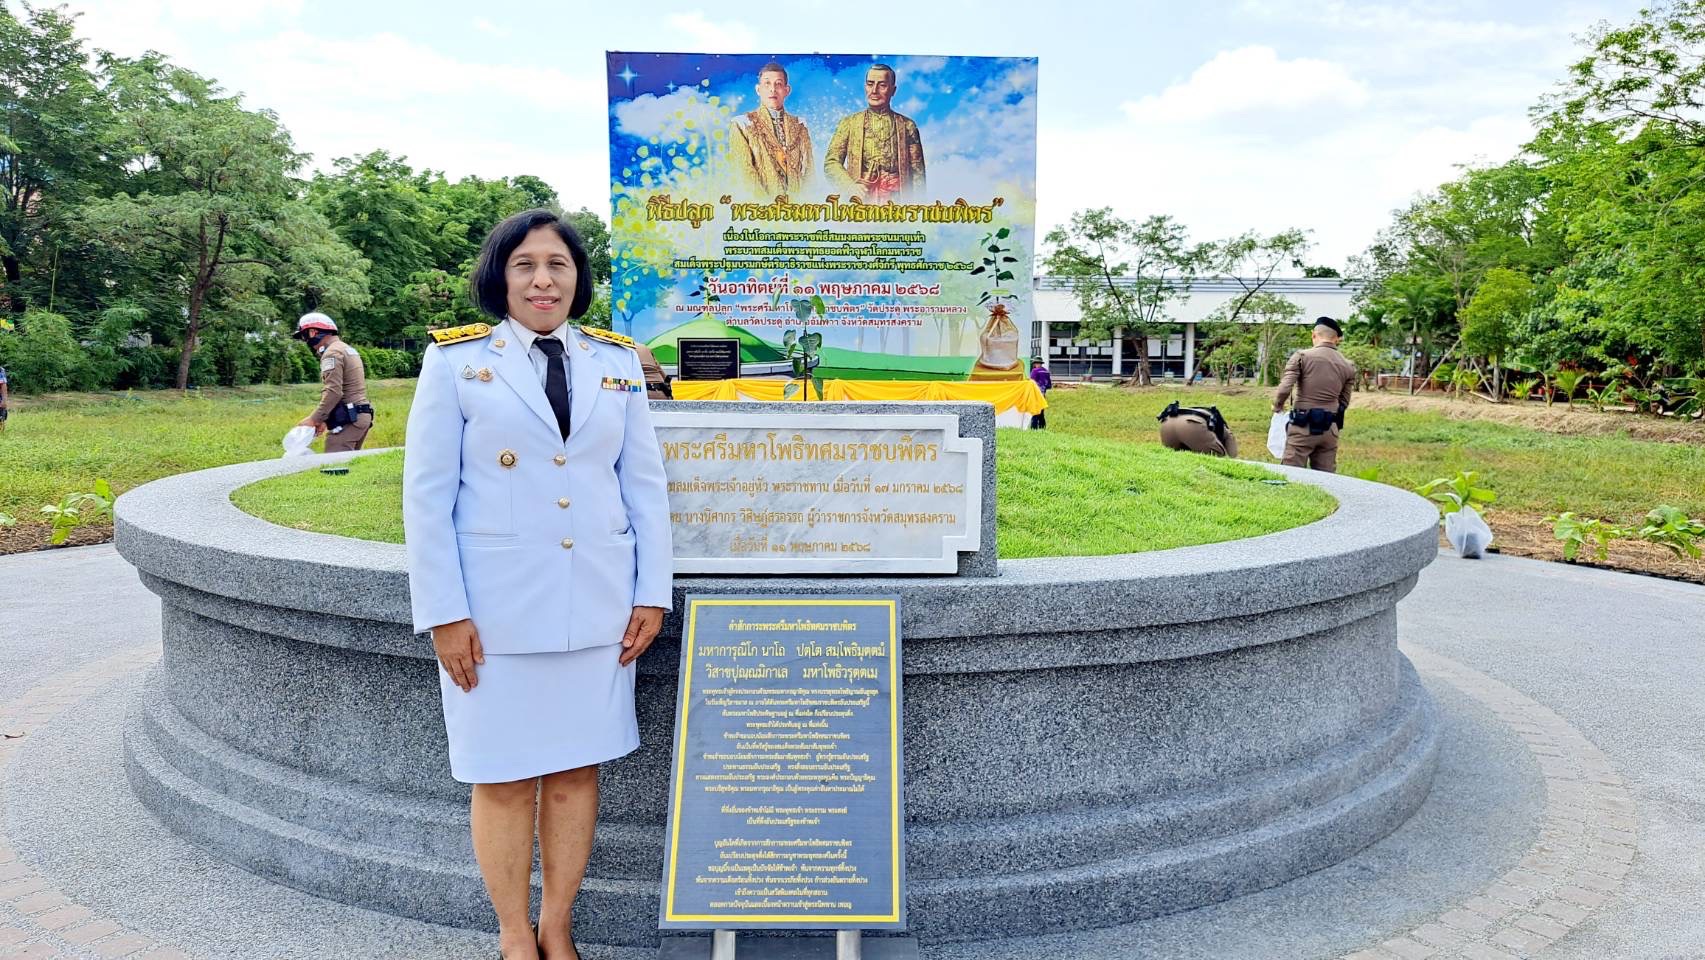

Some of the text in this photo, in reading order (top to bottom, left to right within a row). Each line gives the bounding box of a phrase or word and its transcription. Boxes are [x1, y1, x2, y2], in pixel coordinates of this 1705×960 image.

[647, 195, 714, 229] พิธีปลูก
[708, 274, 940, 298] วันอาทิตย์ที่ ๑๑ พฤษภาคม ๒๕๖๘
[662, 431, 938, 461] พระศรีมหาโพธิทศมราชบพิตร
[772, 480, 829, 494] พระราชทาน
[833, 474, 871, 494] เมื่อวันที่
[892, 482, 930, 494] มกราคม
[933, 483, 964, 494] ๒๕๖๘
[807, 507, 956, 529] ผู้ว่าราชการจังหวัดสมุทรสงคราม
[761, 641, 786, 657] นาโถ
